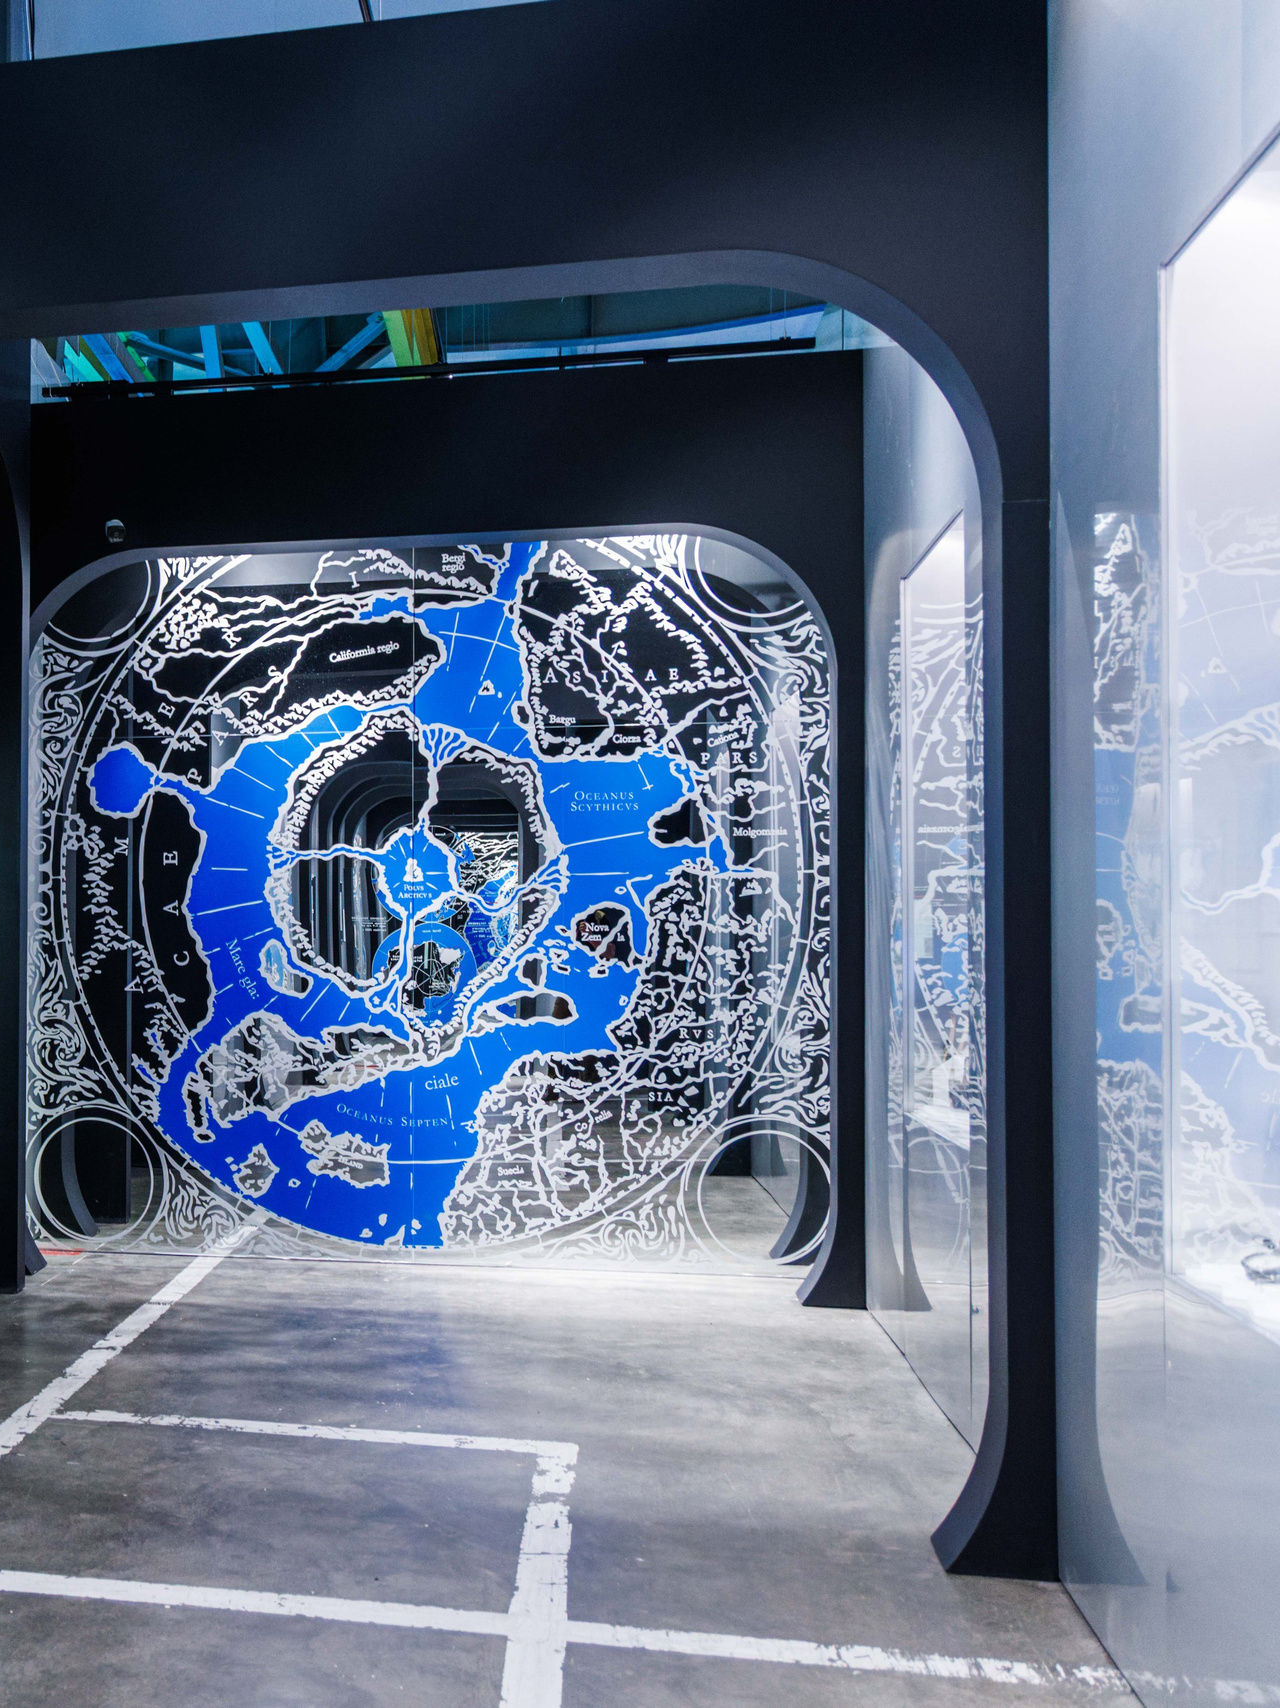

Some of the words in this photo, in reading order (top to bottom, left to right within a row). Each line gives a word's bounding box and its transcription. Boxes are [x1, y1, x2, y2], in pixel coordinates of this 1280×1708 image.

[441, 552, 466, 565] Bergi
[441, 563, 465, 574] regio
[376, 640, 400, 654] regio
[700, 751, 758, 765] PARS
[574, 790, 635, 801] OCEANUS
[570, 801, 639, 812] SCYTHICVS
[585, 923, 610, 932] Nova
[225, 937, 246, 975] Mare
[425, 1073, 460, 1091] ciale
[648, 1091, 674, 1102] SIA
[336, 1103, 394, 1126] OCEANUS
[401, 1116, 449, 1127] SEPTEN
